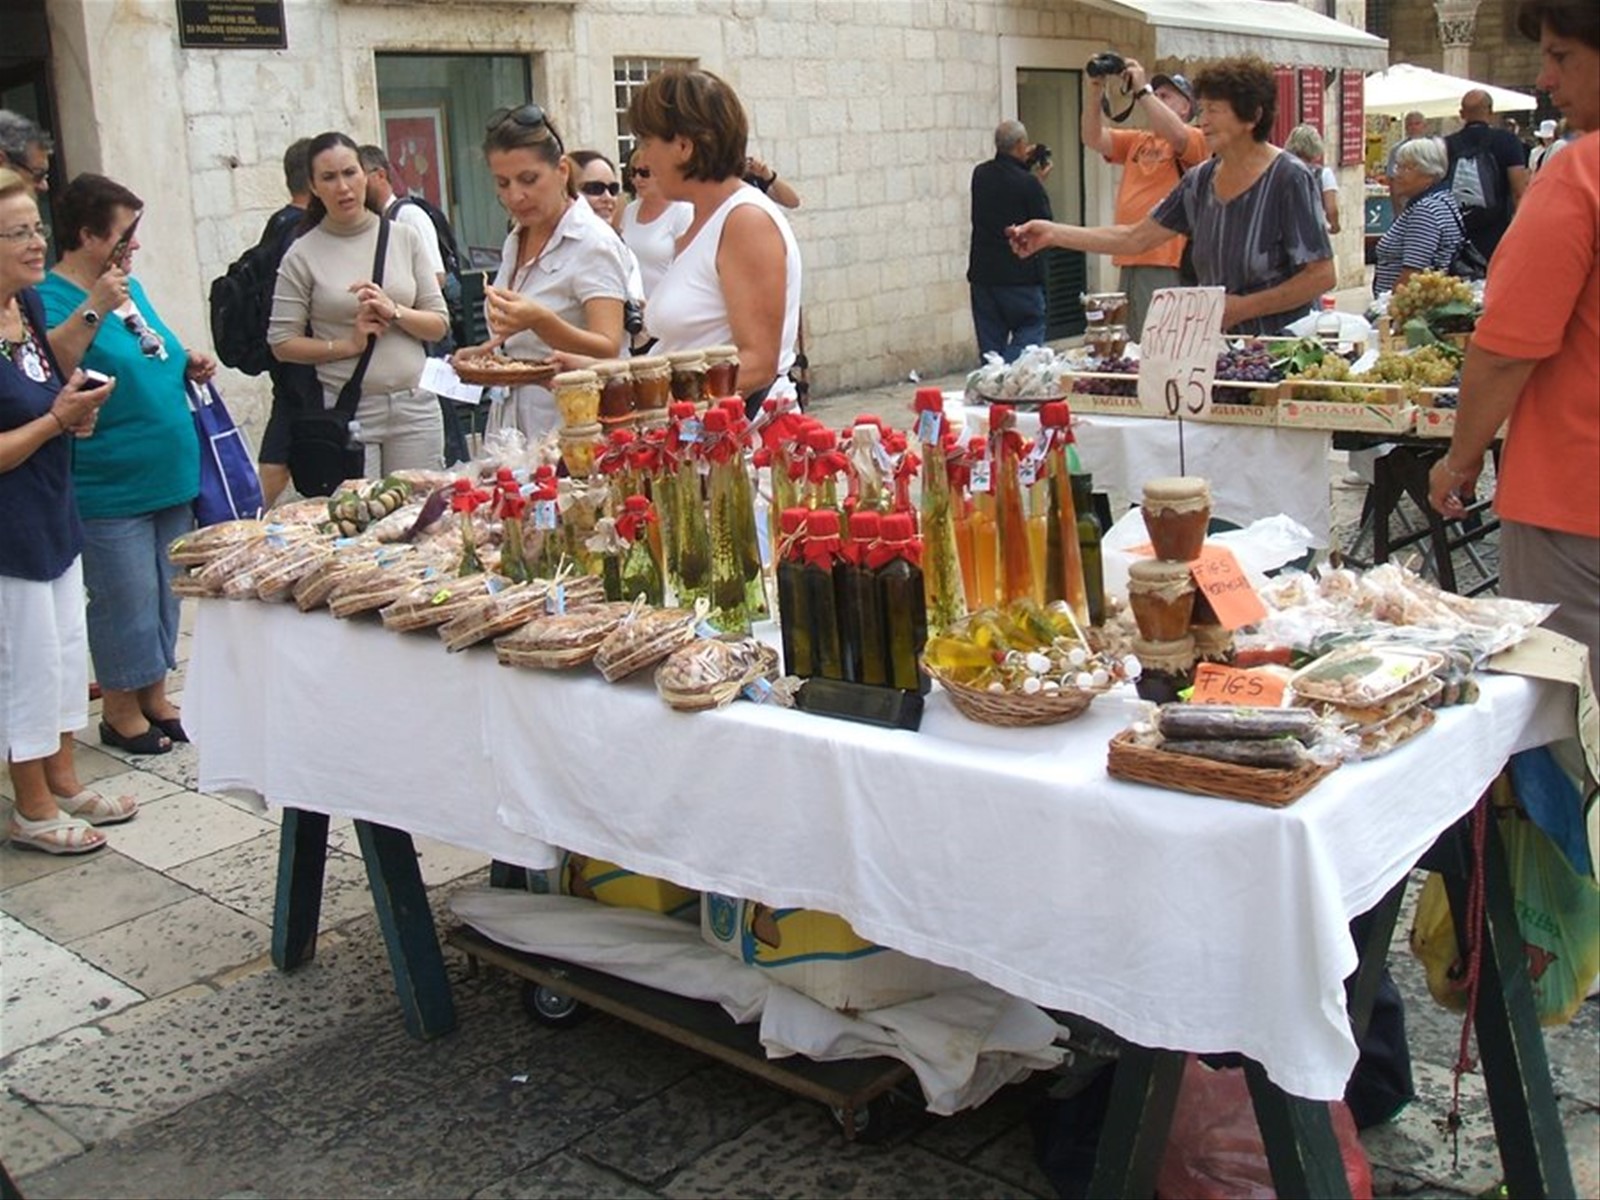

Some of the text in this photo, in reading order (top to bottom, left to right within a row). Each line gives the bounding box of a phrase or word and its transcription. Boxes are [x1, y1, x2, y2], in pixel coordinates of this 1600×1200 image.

[1092, 396, 1143, 410] VAGLIAN
[1302, 404, 1365, 416] ADAMI
[1199, 670, 1264, 696] FIGS
